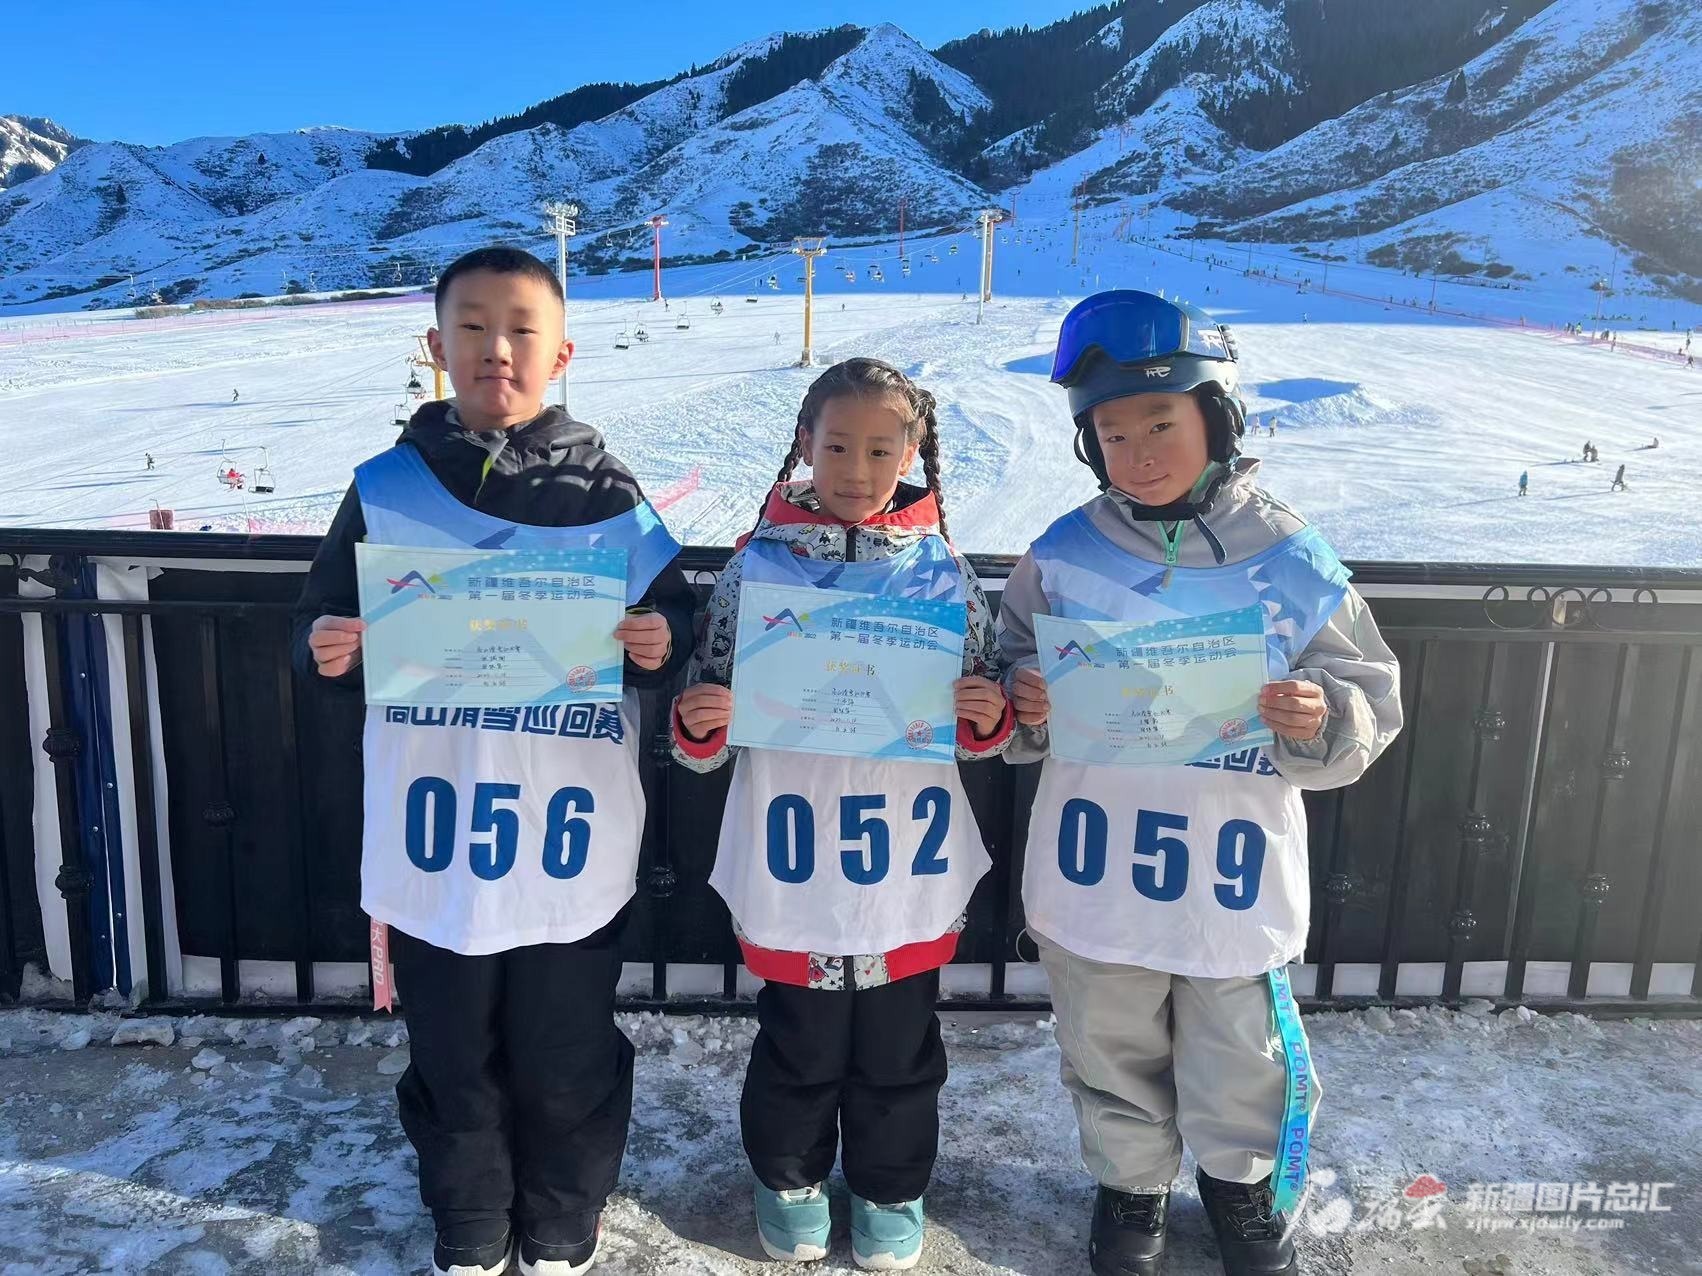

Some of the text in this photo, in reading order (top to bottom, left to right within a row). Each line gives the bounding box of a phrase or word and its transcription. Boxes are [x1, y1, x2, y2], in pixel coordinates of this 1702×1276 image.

[468, 575, 596, 588] 新疆维吾尔自治区
[468, 589, 597, 601] 第一届冬季运动会
[830, 617, 939, 638] 新疆维吾尔自治区
[829, 631, 938, 650] 第一届冬季运动会
[1115, 636, 1236, 658] 新疆维吾尔自治区
[1118, 647, 1237, 669] 第一届冬季运动会
[405, 776, 595, 881] 056
[766, 786, 952, 886] 052
[1057, 797, 1267, 911] 059
